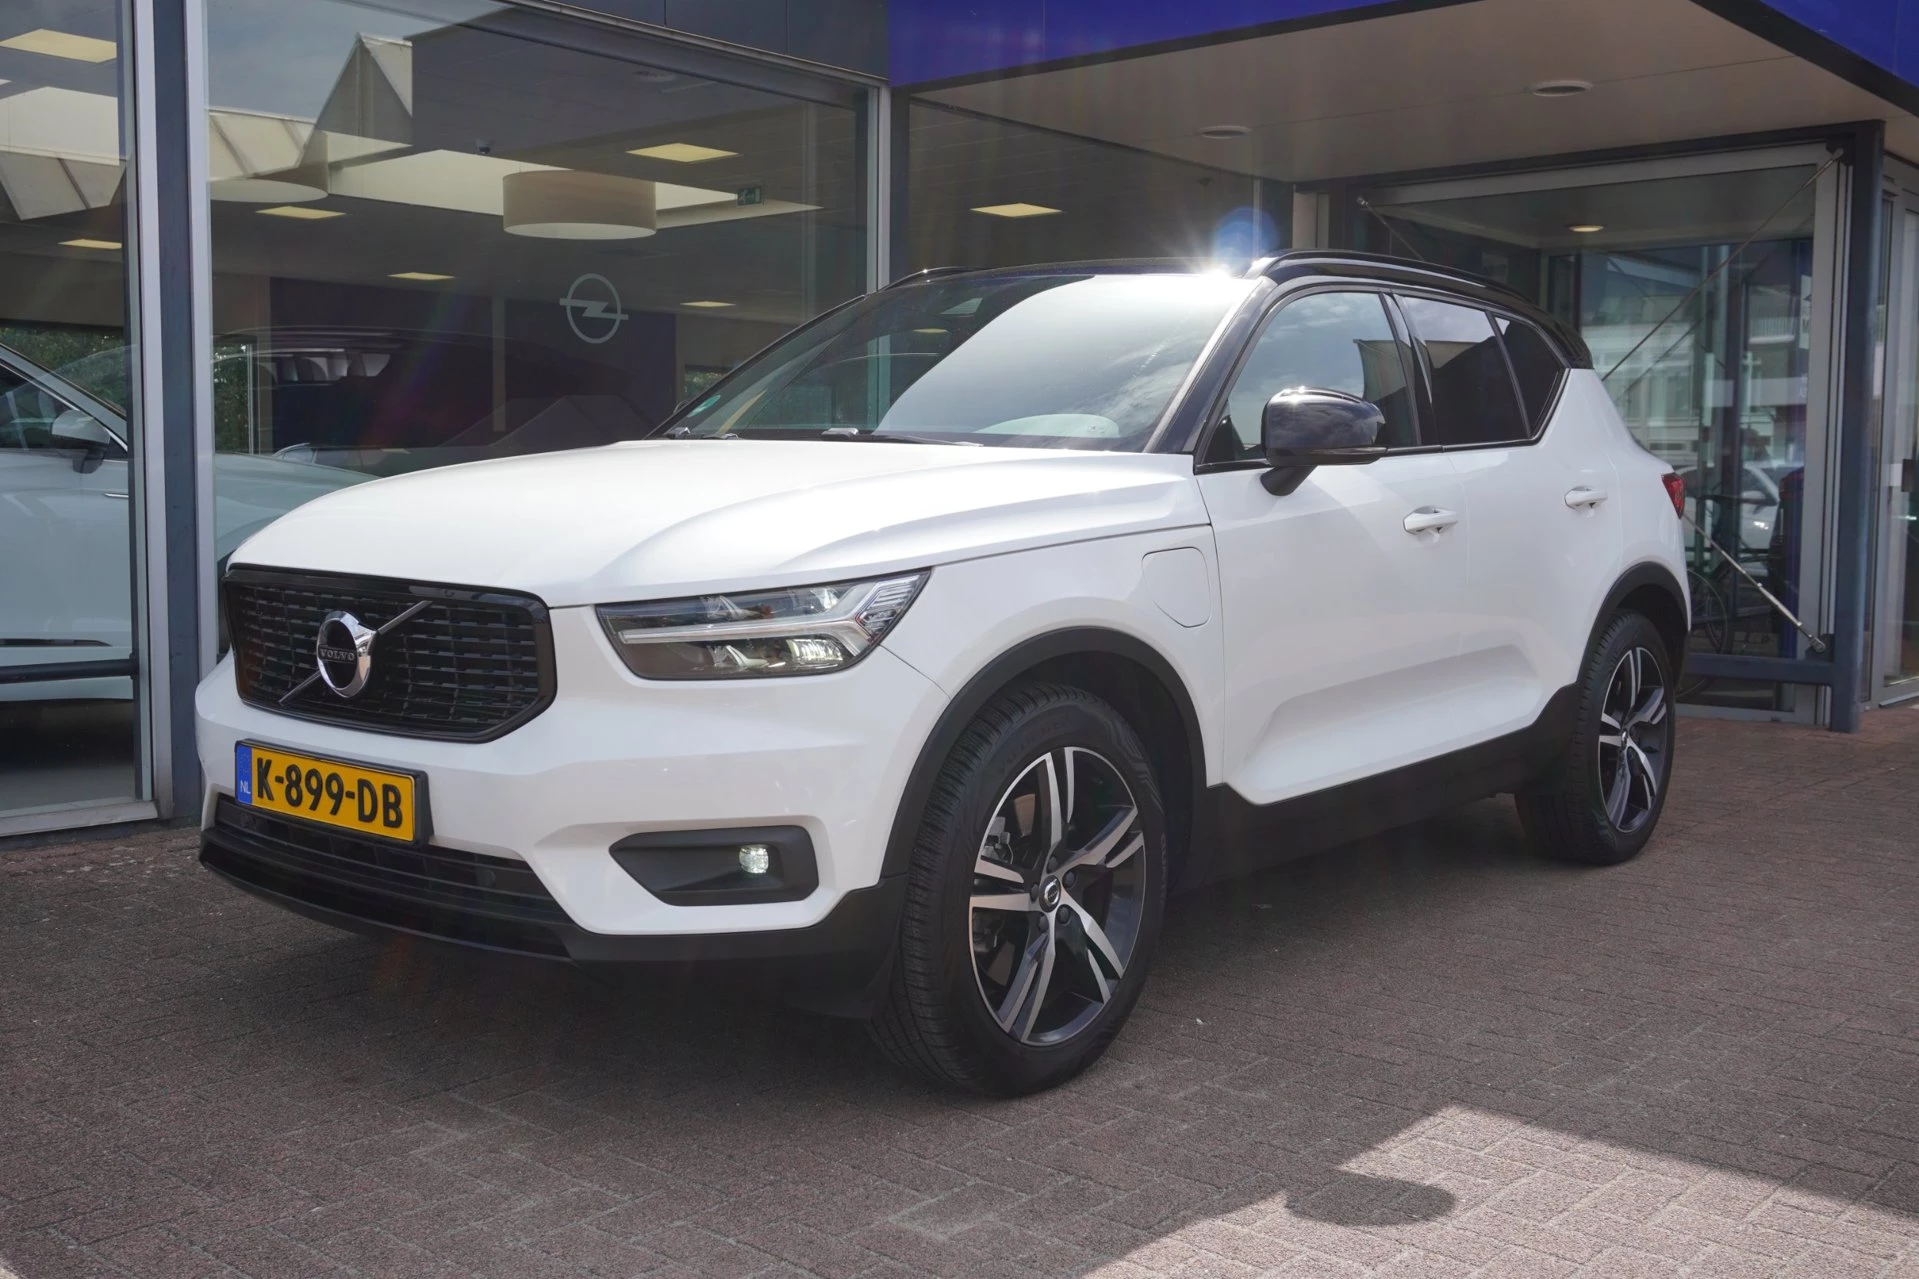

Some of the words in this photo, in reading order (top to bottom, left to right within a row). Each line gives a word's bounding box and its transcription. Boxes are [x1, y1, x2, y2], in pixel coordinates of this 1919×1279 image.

[320, 648, 355, 661] VOLVO
[240, 780, 251, 795] NL
[256, 757, 403, 829] K-899-DB
